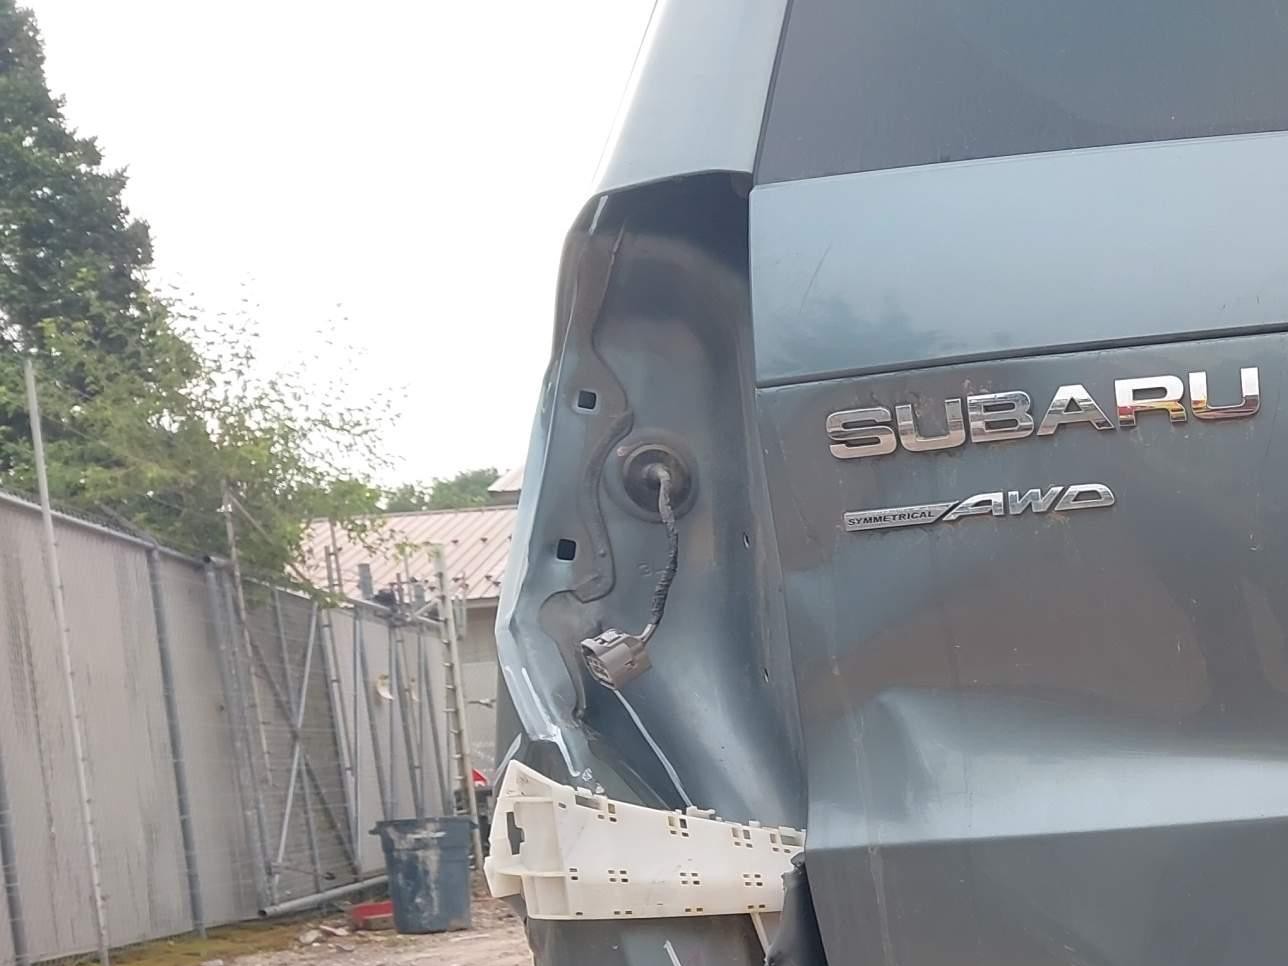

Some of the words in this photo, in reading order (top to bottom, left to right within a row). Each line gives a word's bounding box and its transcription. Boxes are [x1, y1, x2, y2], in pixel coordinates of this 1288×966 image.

[825, 367, 1260, 459] SUBARU
[847, 511, 935, 526] SYMMETRICAL
[942, 483, 1115, 521] AWD
